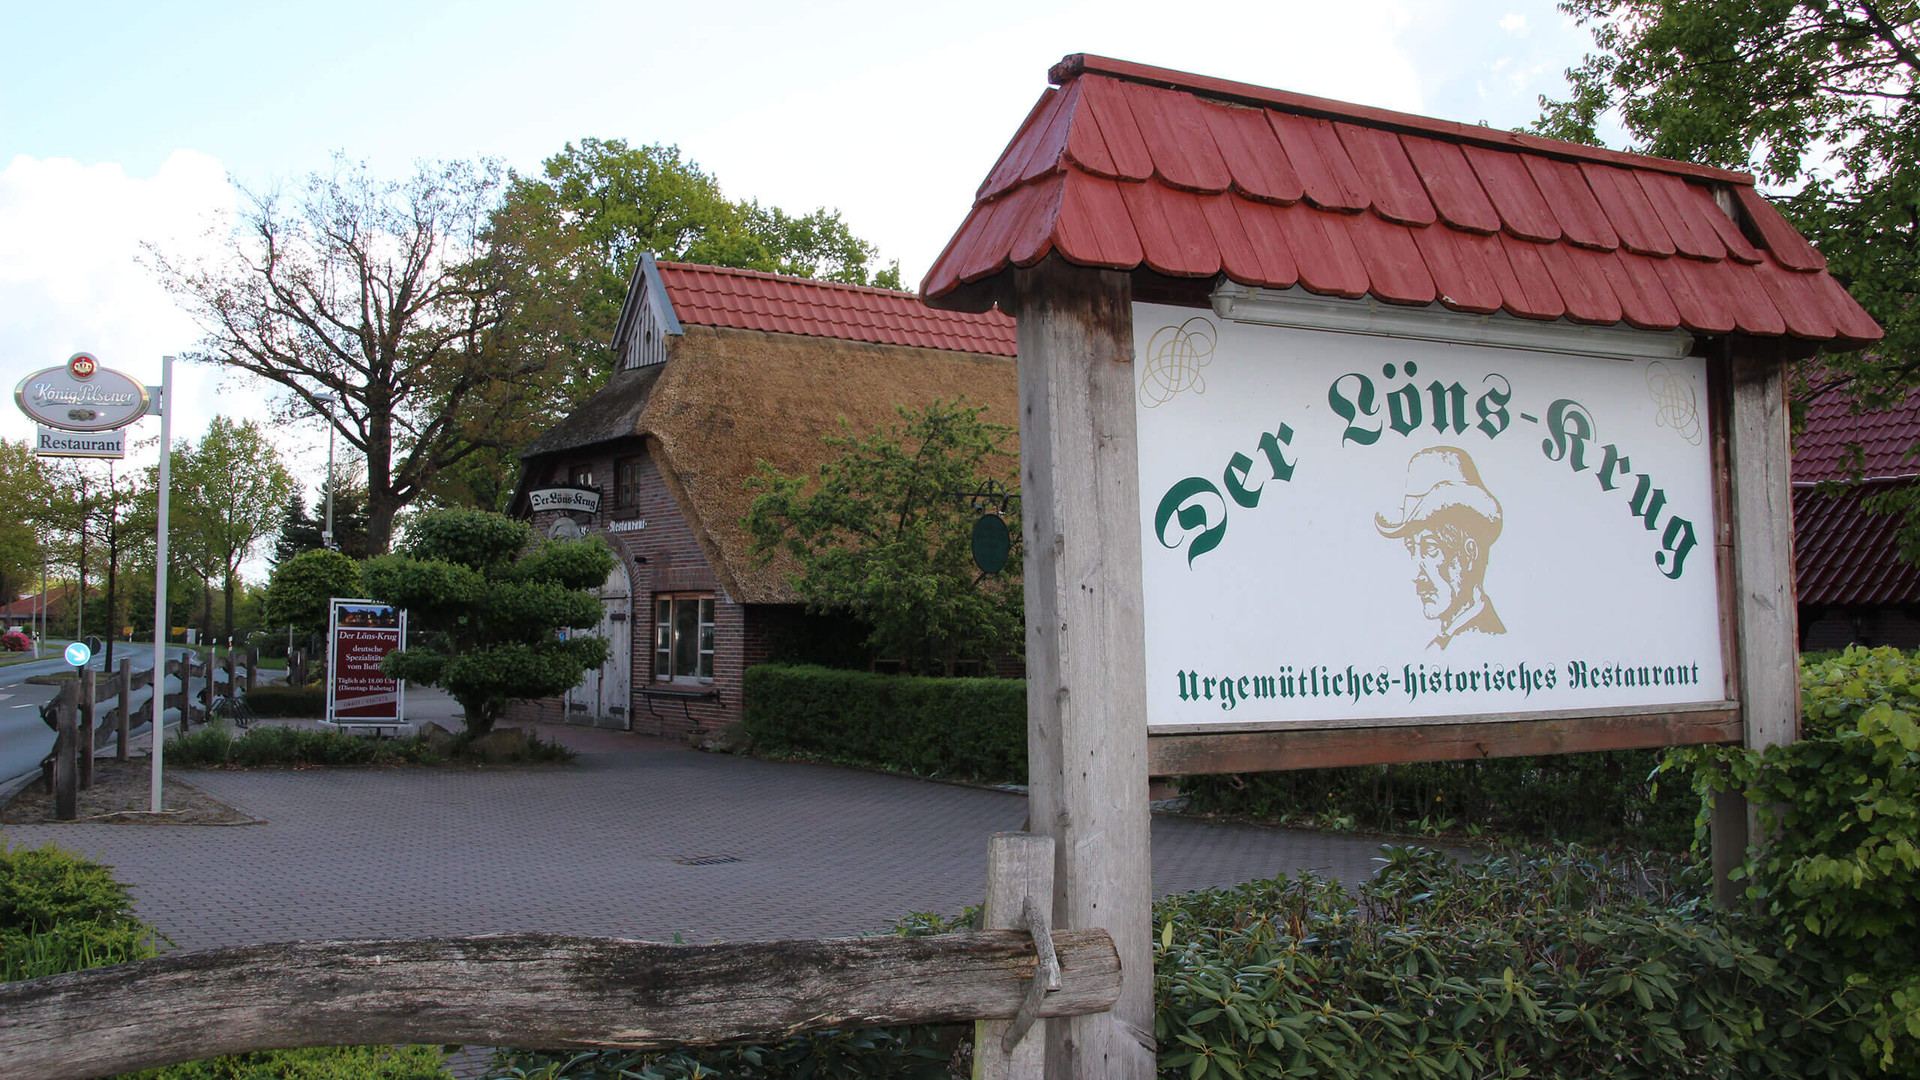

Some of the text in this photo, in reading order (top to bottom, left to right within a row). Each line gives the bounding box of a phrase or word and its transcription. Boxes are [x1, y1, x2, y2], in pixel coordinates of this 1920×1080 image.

[34, 382, 135, 404] König Pilsener
[40, 434, 121, 451] Restaurant
[1154, 361, 1698, 580] Der Löns-Krug
[532, 493, 549, 507] Der
[339, 631, 397, 641] Der Löns-Krug
[345, 653, 384, 662] Spezialitäte
[1176, 659, 1699, 711] Urgemütliches-historisches Restaurant
